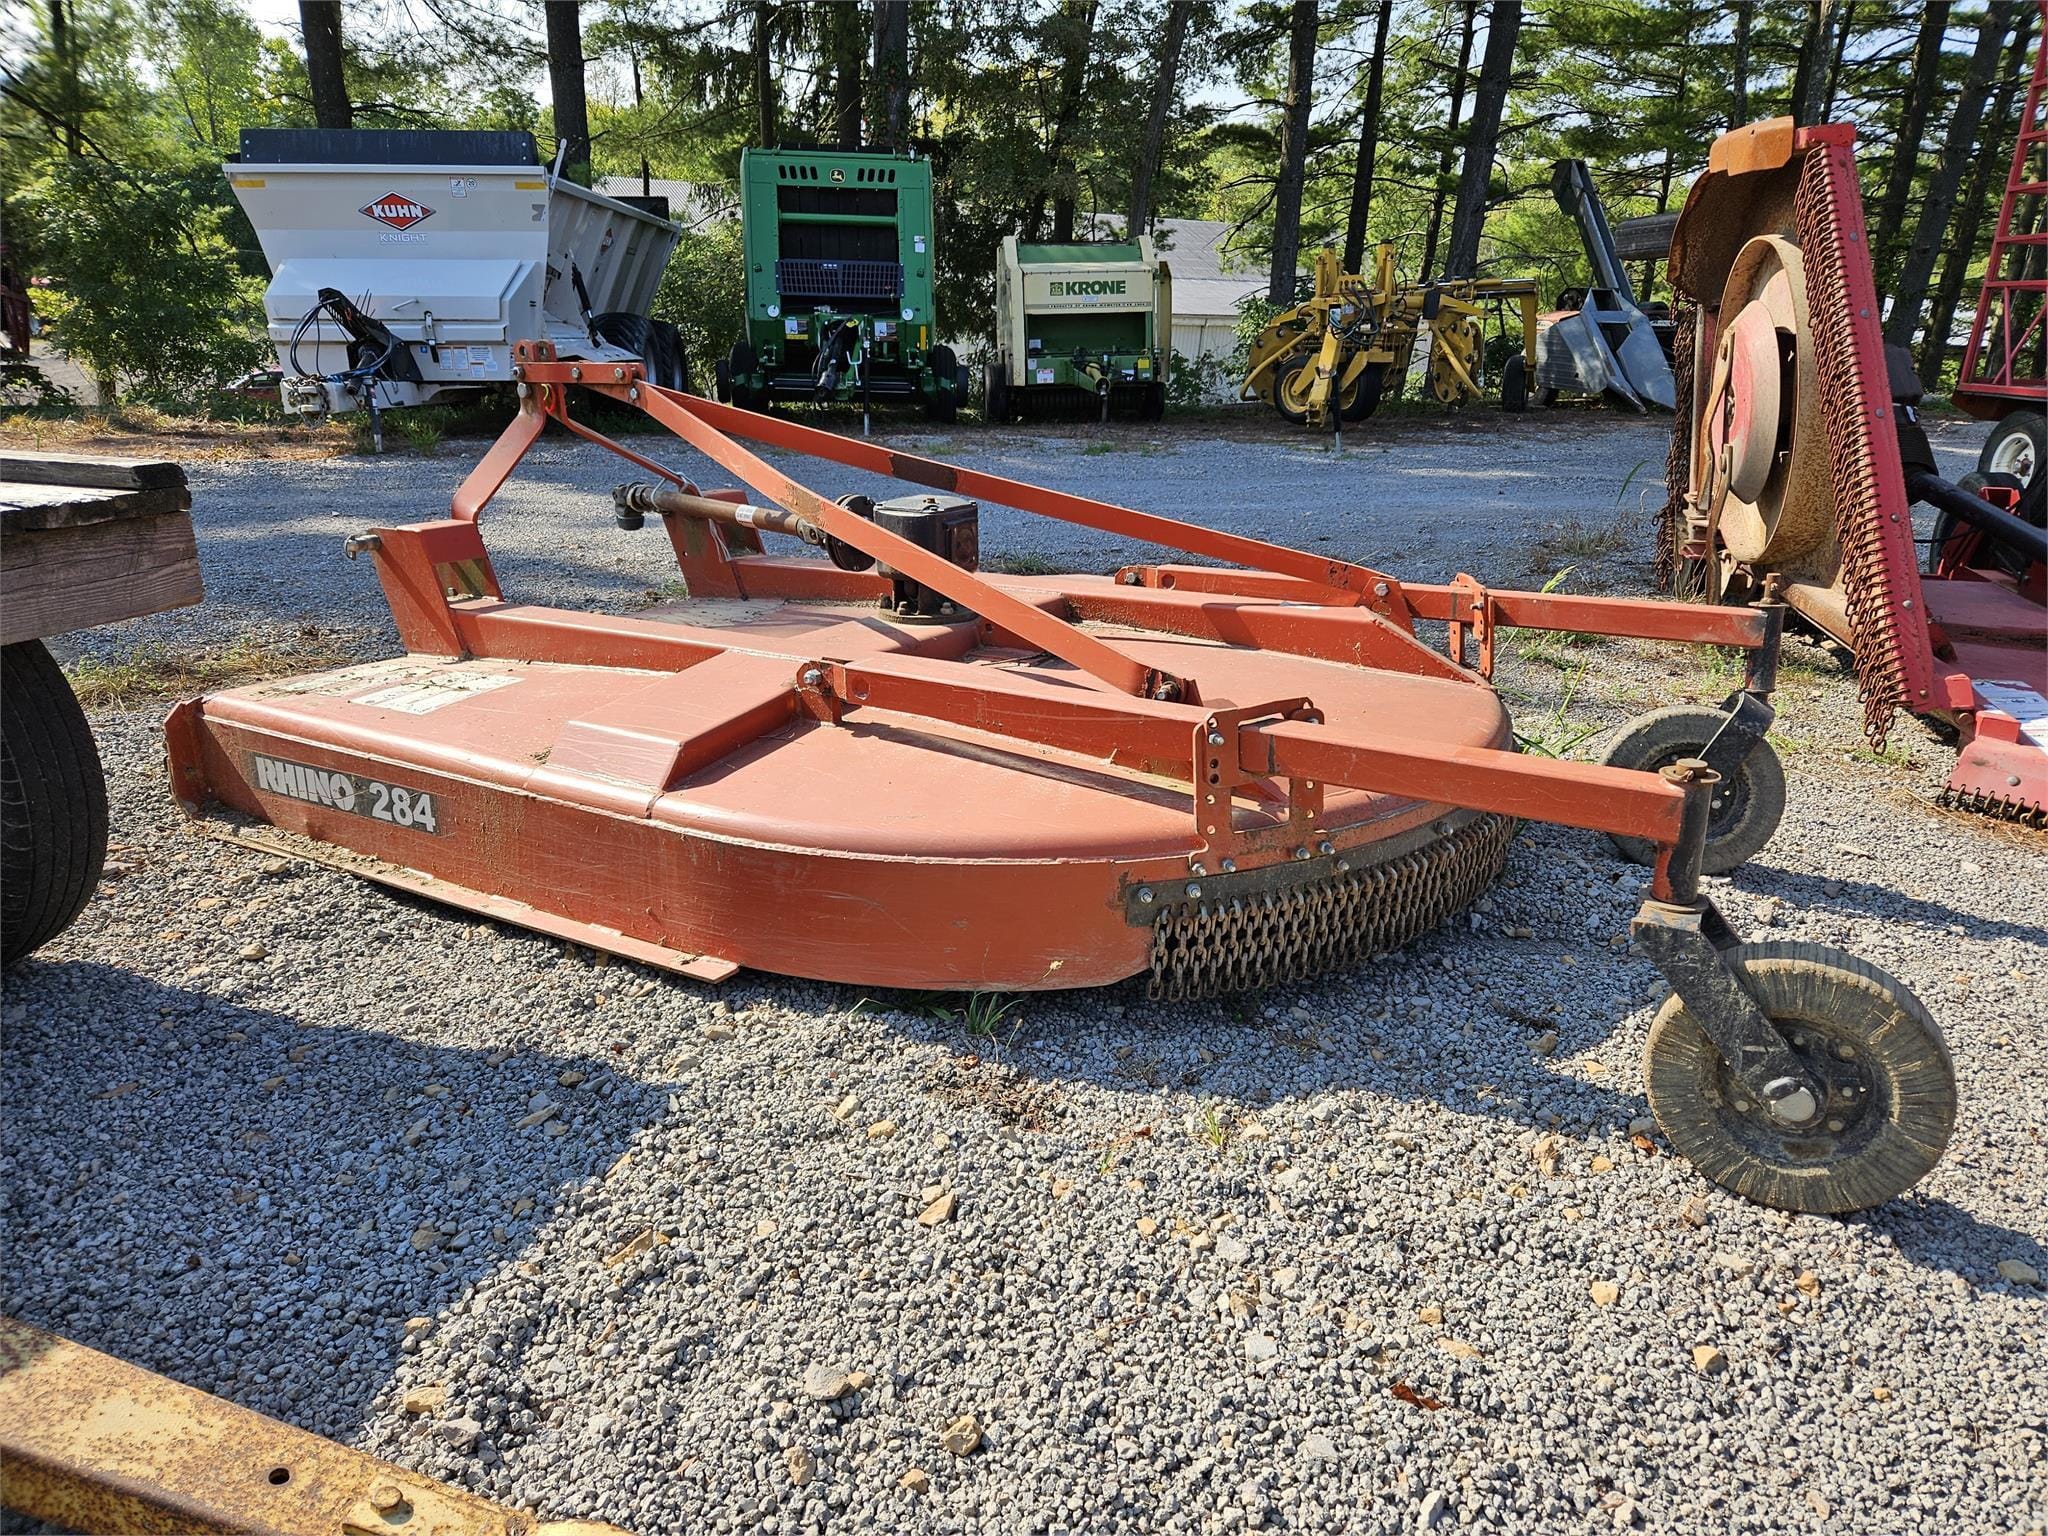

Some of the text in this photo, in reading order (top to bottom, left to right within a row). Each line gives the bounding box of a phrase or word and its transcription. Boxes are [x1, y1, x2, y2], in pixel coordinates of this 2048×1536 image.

[371, 204, 424, 218] KUHN
[379, 233, 427, 242] KNIGHT
[1065, 280, 1126, 295] KRONE
[255, 756, 436, 832] RHINO 284
